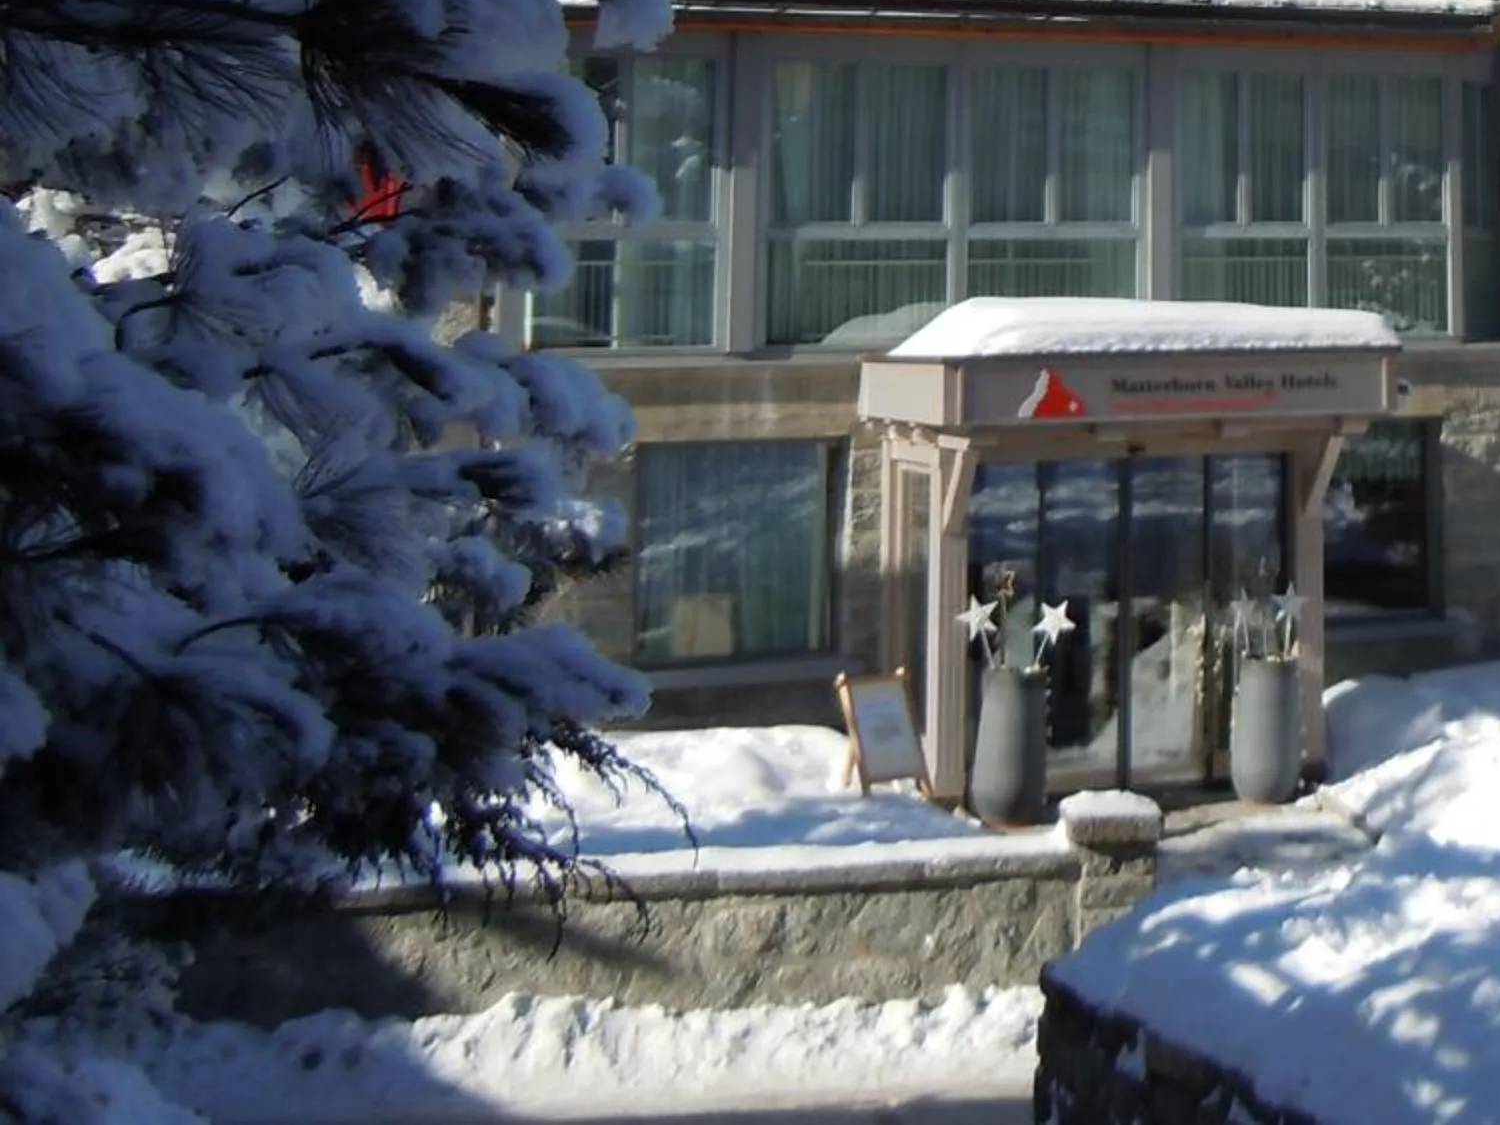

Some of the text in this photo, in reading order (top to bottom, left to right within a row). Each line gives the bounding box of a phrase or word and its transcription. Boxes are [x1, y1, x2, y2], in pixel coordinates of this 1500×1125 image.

[1111, 371, 1338, 394] Matterhorn Valley Hotels
